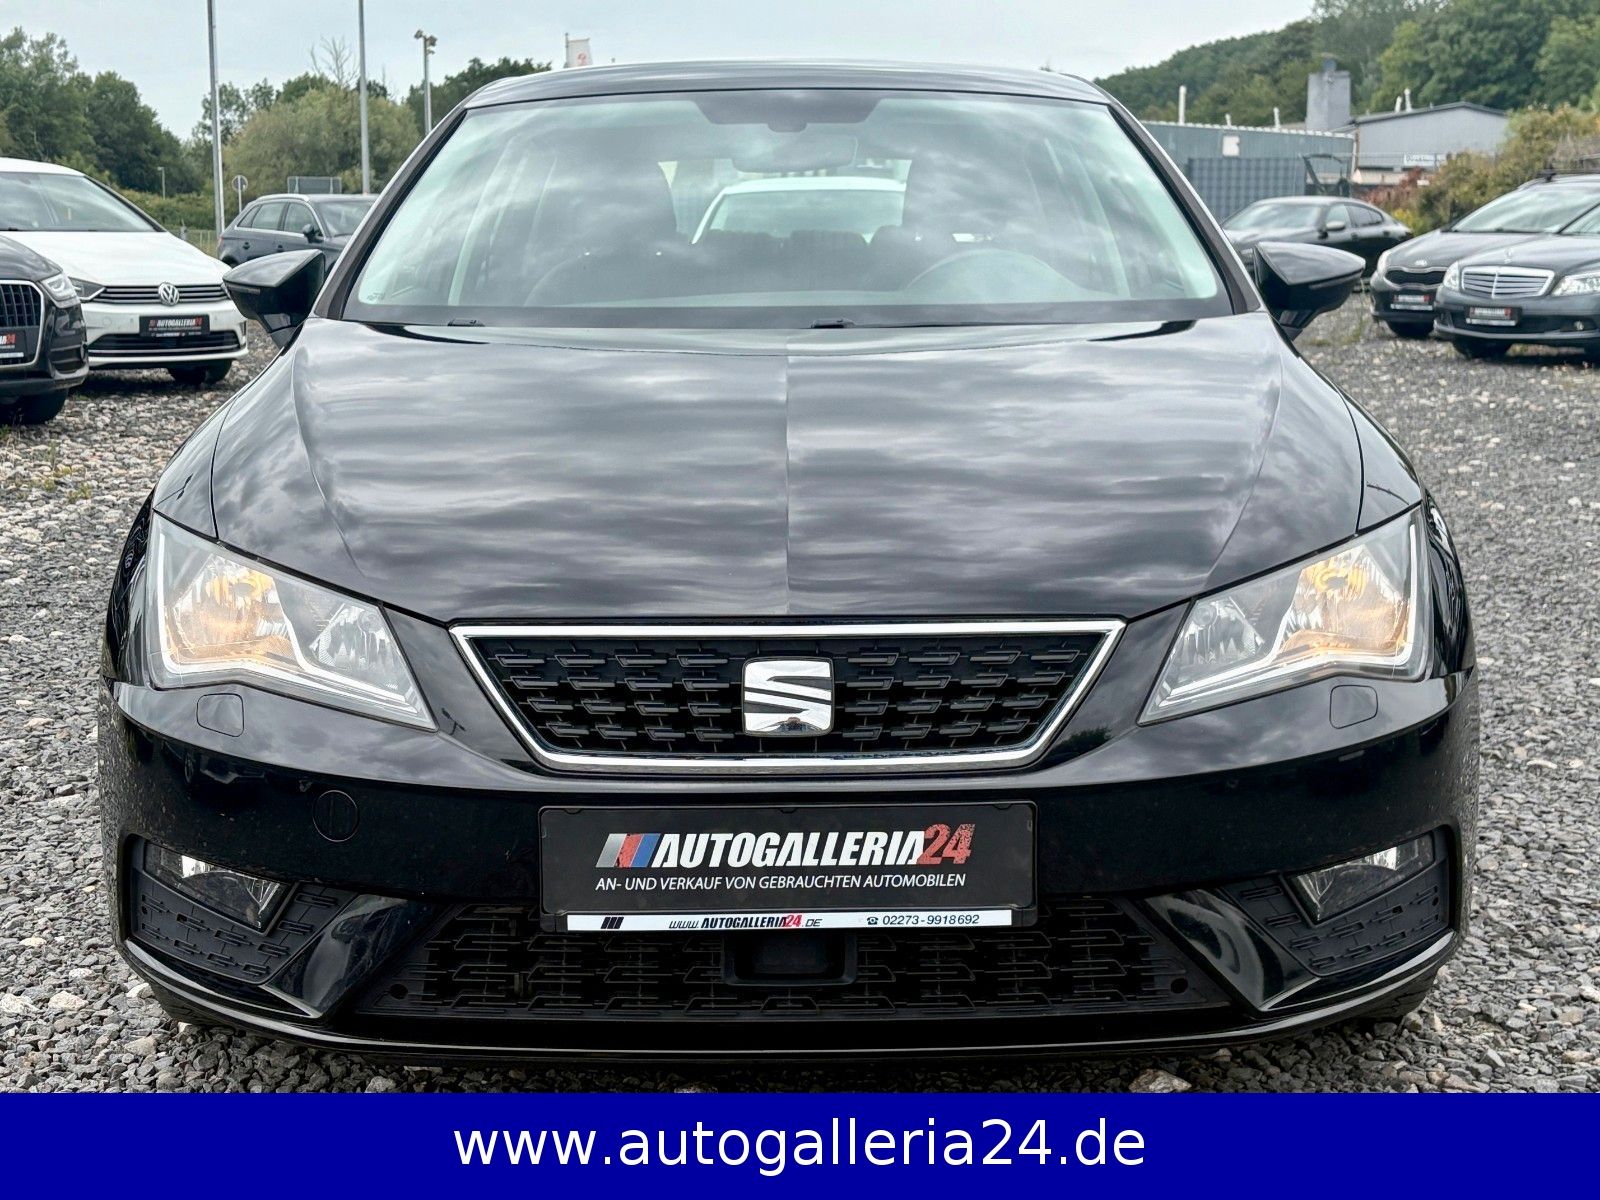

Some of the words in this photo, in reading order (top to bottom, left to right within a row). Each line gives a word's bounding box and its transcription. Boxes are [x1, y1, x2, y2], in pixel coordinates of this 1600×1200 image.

[651, 823, 975, 868] AUTOGALLERIA24
[595, 877, 621, 890] AN-
[625, 877, 657, 890] UND
[661, 876, 722, 890] VERKAUF
[725, 876, 756, 890] VON
[759, 875, 861, 889] GEBRAUCHTEN
[863, 874, 966, 888] AUTOMOBILEN
